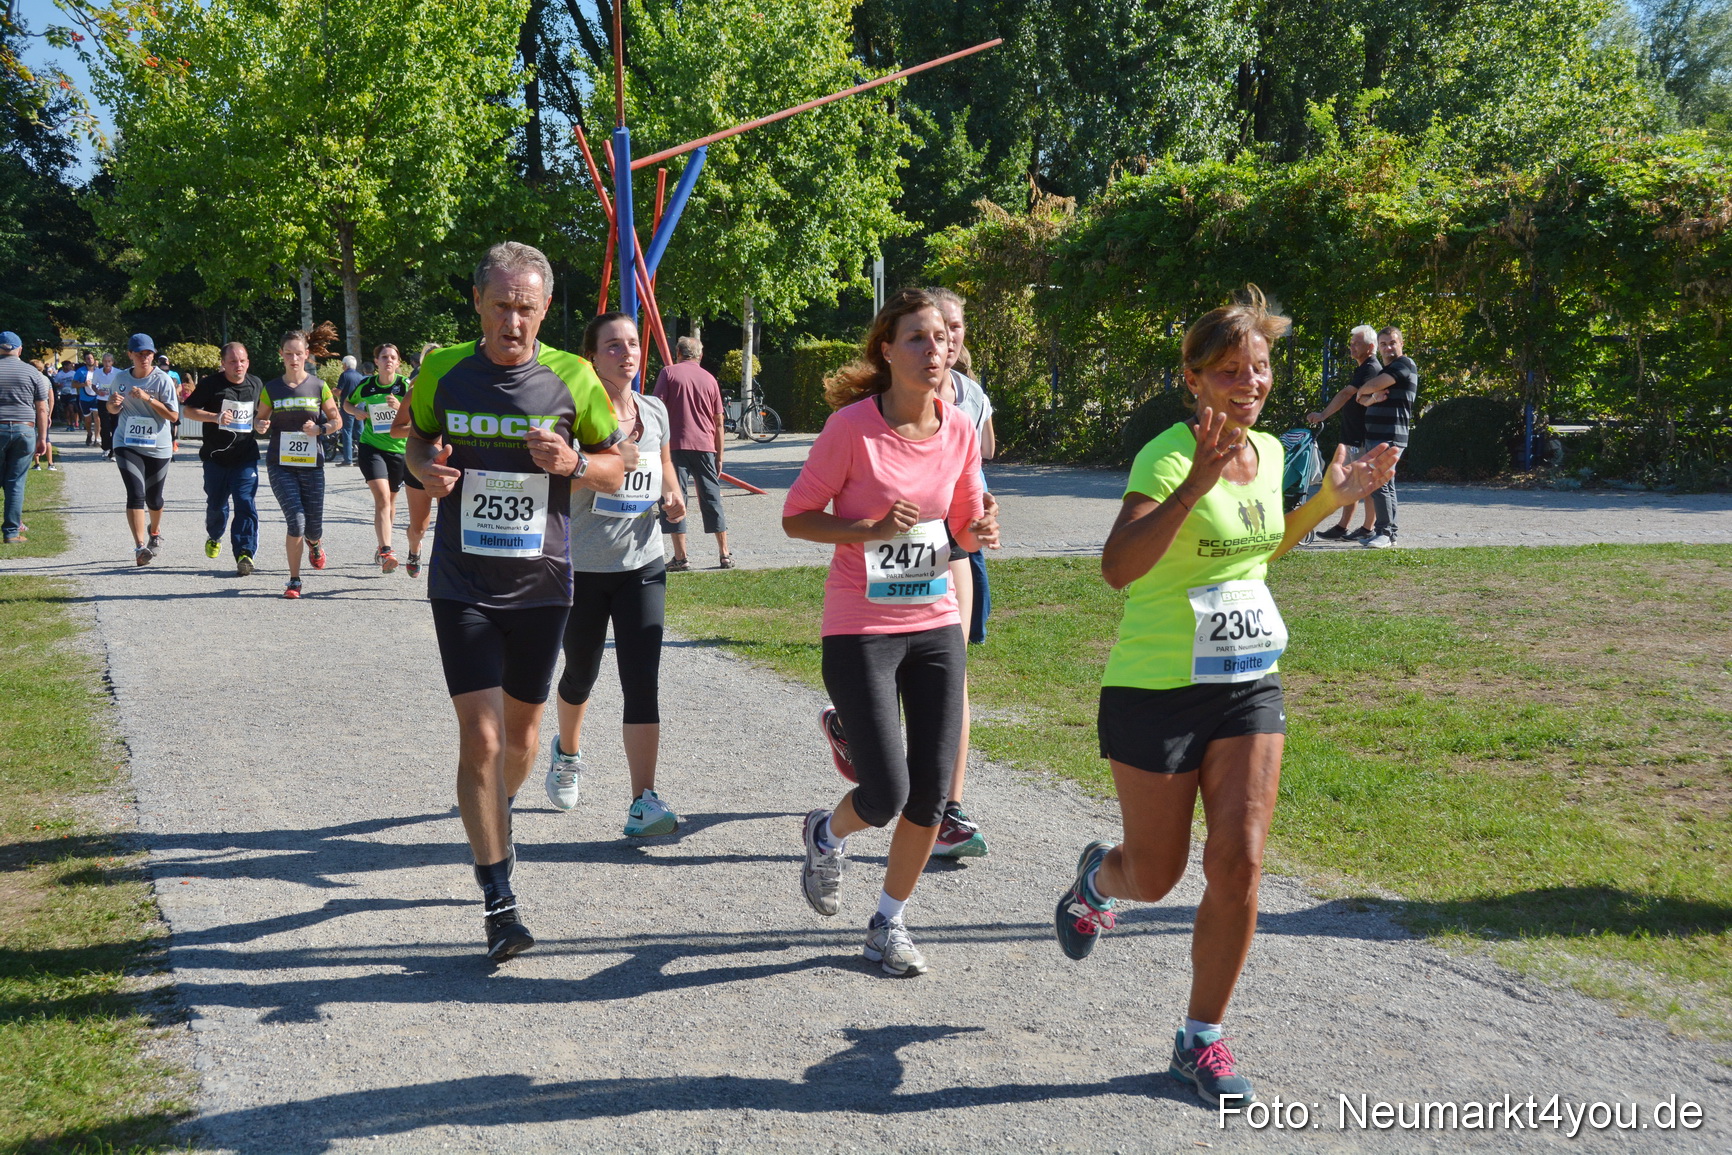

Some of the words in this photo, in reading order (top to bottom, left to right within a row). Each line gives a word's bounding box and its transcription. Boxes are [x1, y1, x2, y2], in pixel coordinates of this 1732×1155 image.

[273, 397, 319, 409] BOCK
[375, 410, 396, 421] 3003
[130, 425, 152, 435] 2014
[446, 411, 560, 439] BOCK
[289, 441, 309, 452] 287
[493, 440, 520, 449] smart
[486, 479, 523, 489] BOCK
[473, 494, 534, 521] 2533
[621, 503, 637, 511] Lisa
[477, 522, 494, 530] PARTL
[480, 534, 524, 547] Helmuth
[1199, 539, 1220, 548] SC
[879, 542, 936, 570] 2471
[887, 582, 930, 596] STEFFI
[1238, 642, 1264, 650] Neumarkt
[1223, 657, 1262, 672] Brigitte
